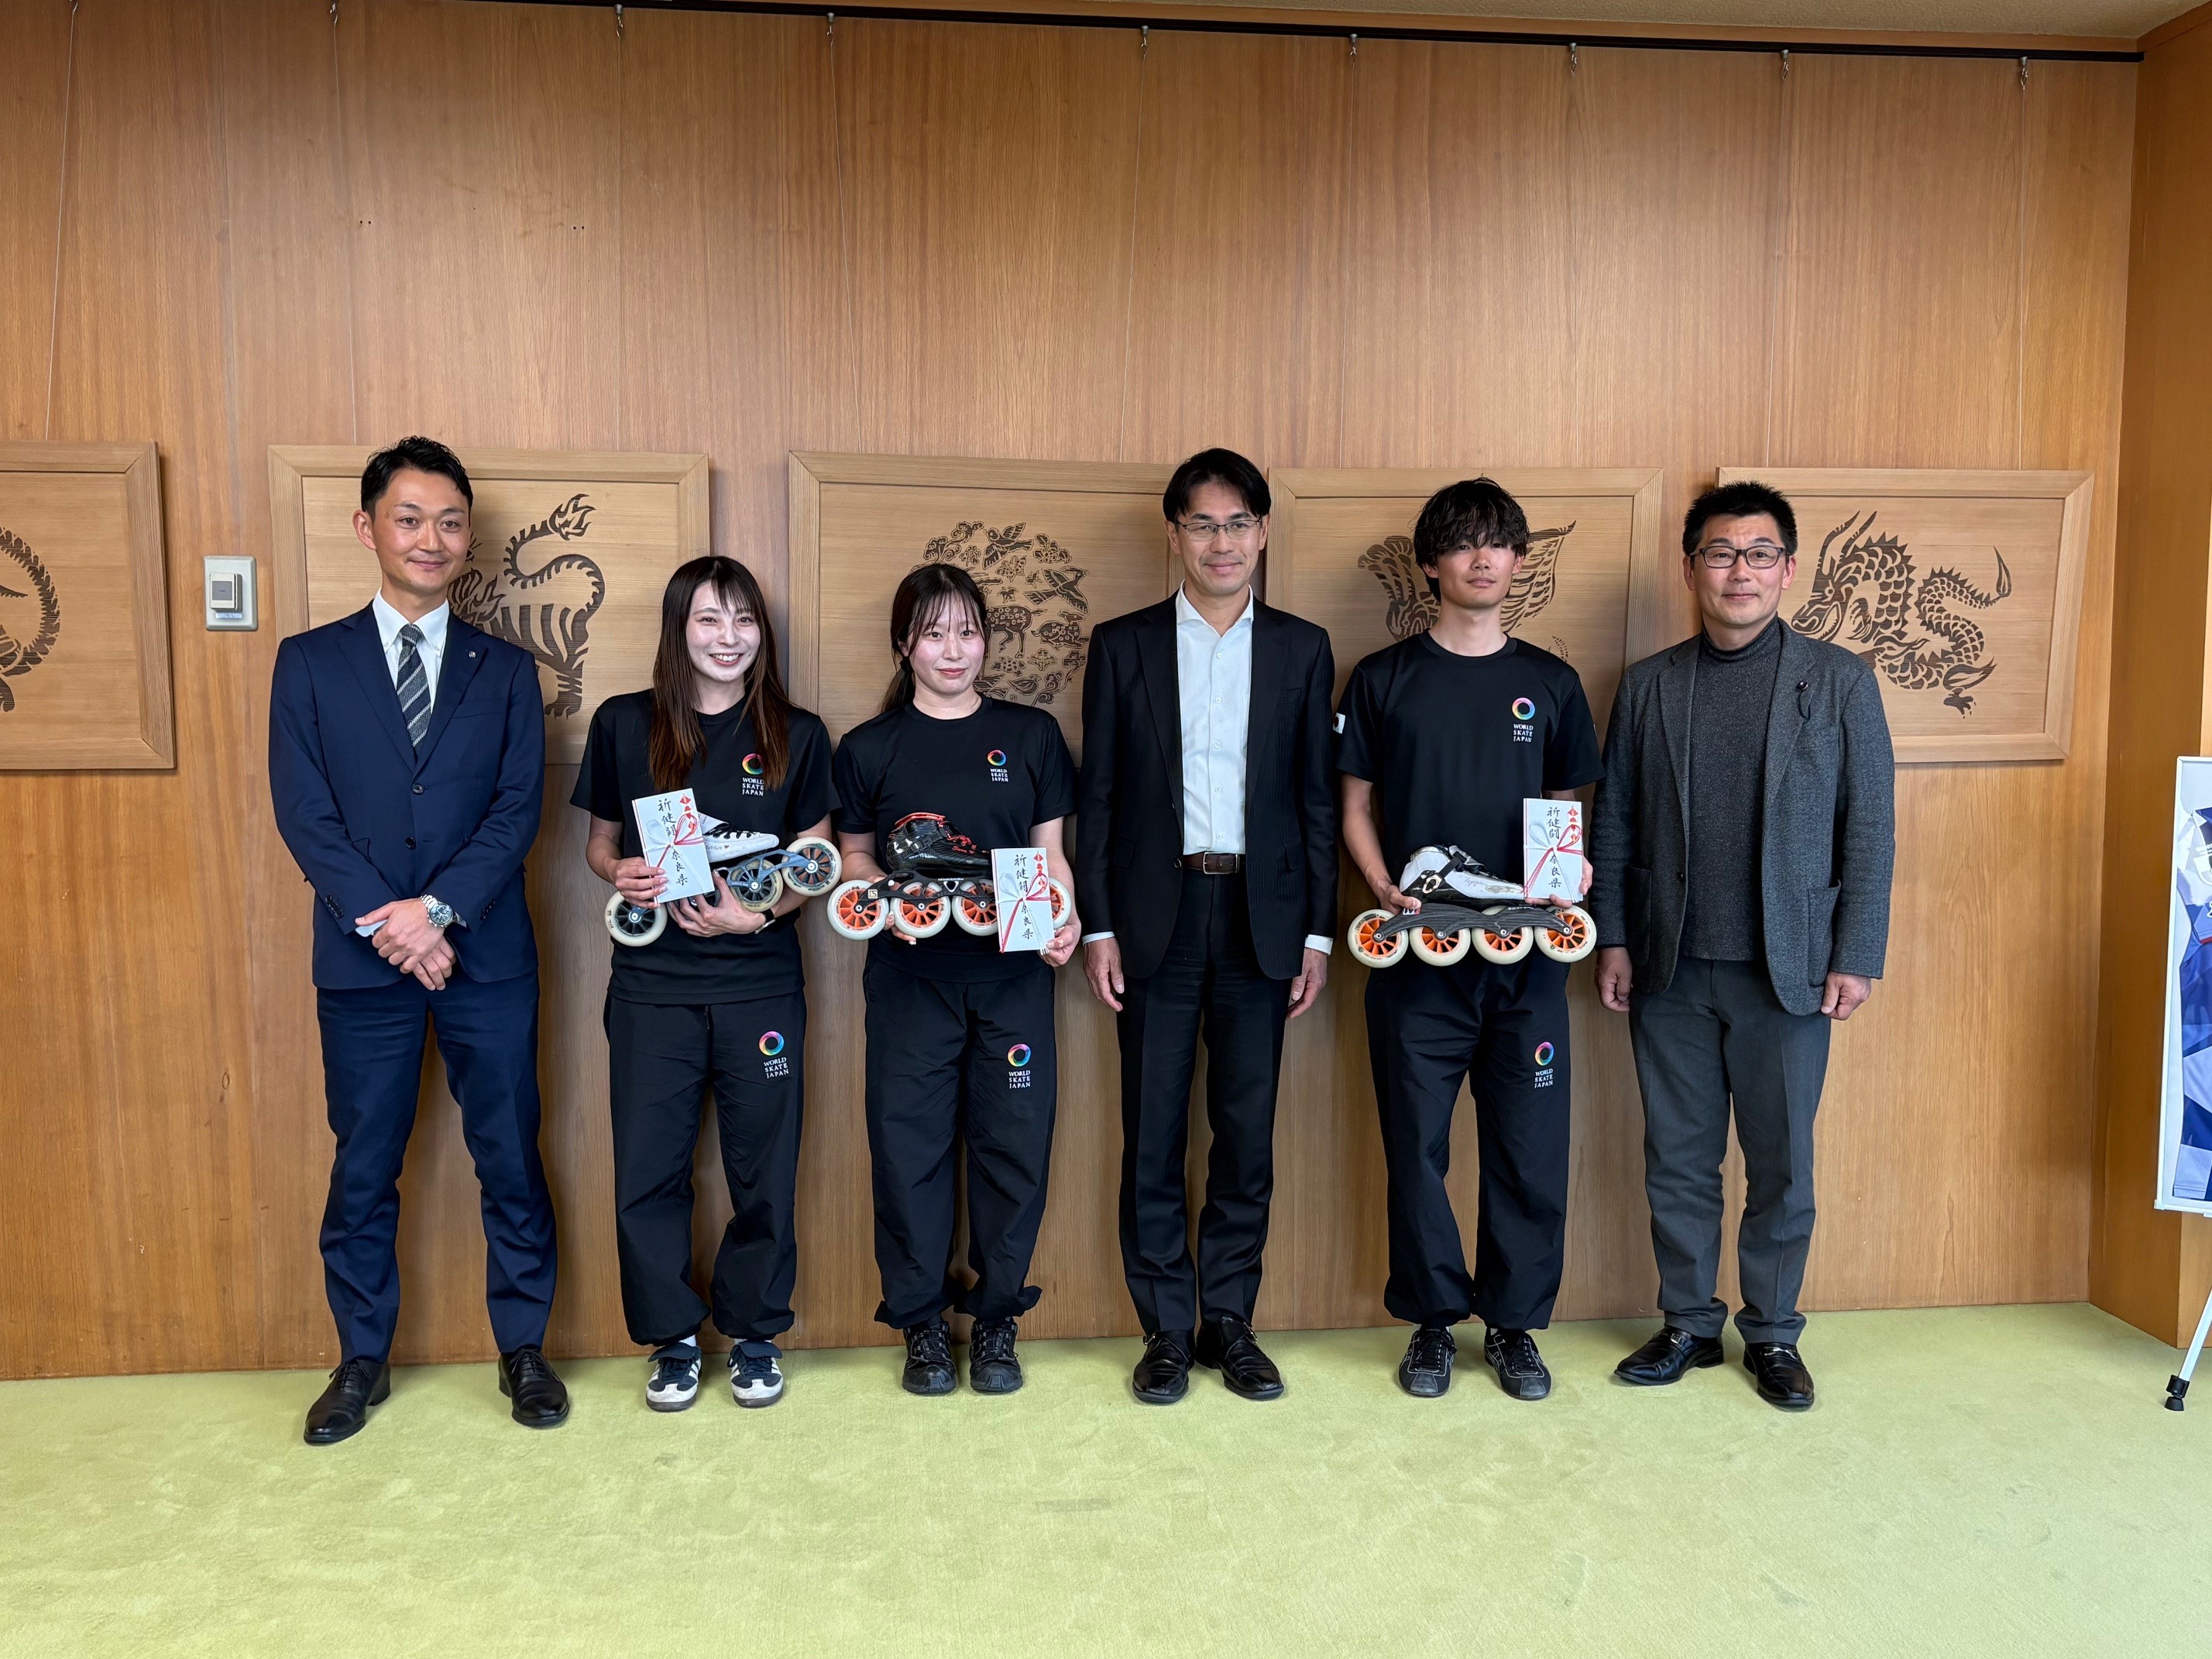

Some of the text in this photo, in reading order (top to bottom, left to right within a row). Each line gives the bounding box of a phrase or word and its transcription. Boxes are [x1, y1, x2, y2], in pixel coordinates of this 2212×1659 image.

[1548, 853, 1561, 888] 奈良県
[763, 1056, 787, 1066] WORLD
[764, 1063, 788, 1073] SKATE
[1535, 1068, 1553, 1077] WORLD
[766, 1068, 789, 1079] JAPAN
[1534, 1073, 1554, 1083] SKATE
[1534, 1080, 1554, 1089] JAPAN
